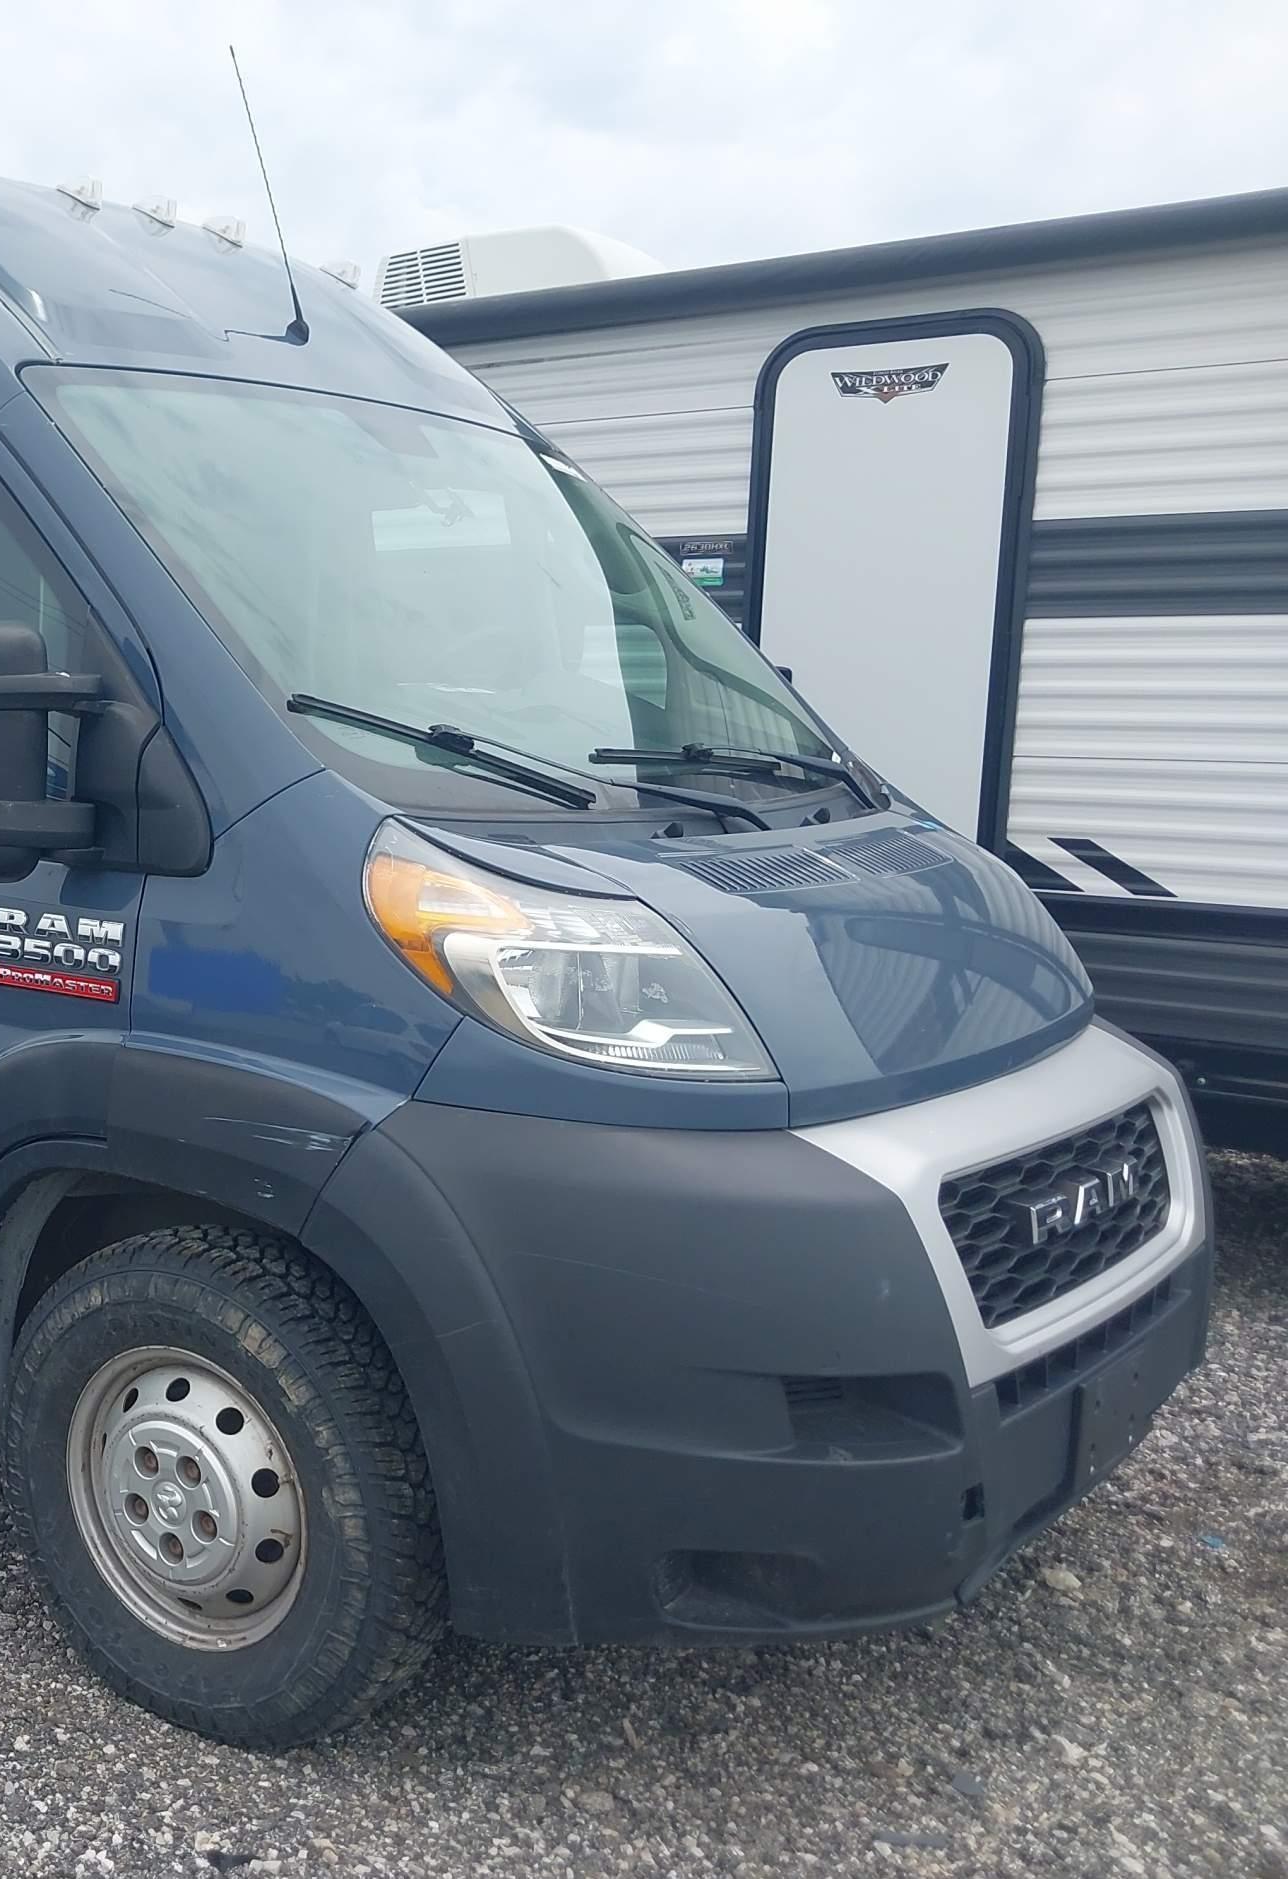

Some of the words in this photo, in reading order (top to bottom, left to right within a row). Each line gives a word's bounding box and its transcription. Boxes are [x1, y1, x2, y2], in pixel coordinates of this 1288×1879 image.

[834, 371, 942, 388] WILDWOOD
[882, 383, 922, 393] LITE
[1029, 1158, 1137, 1245] RAM
